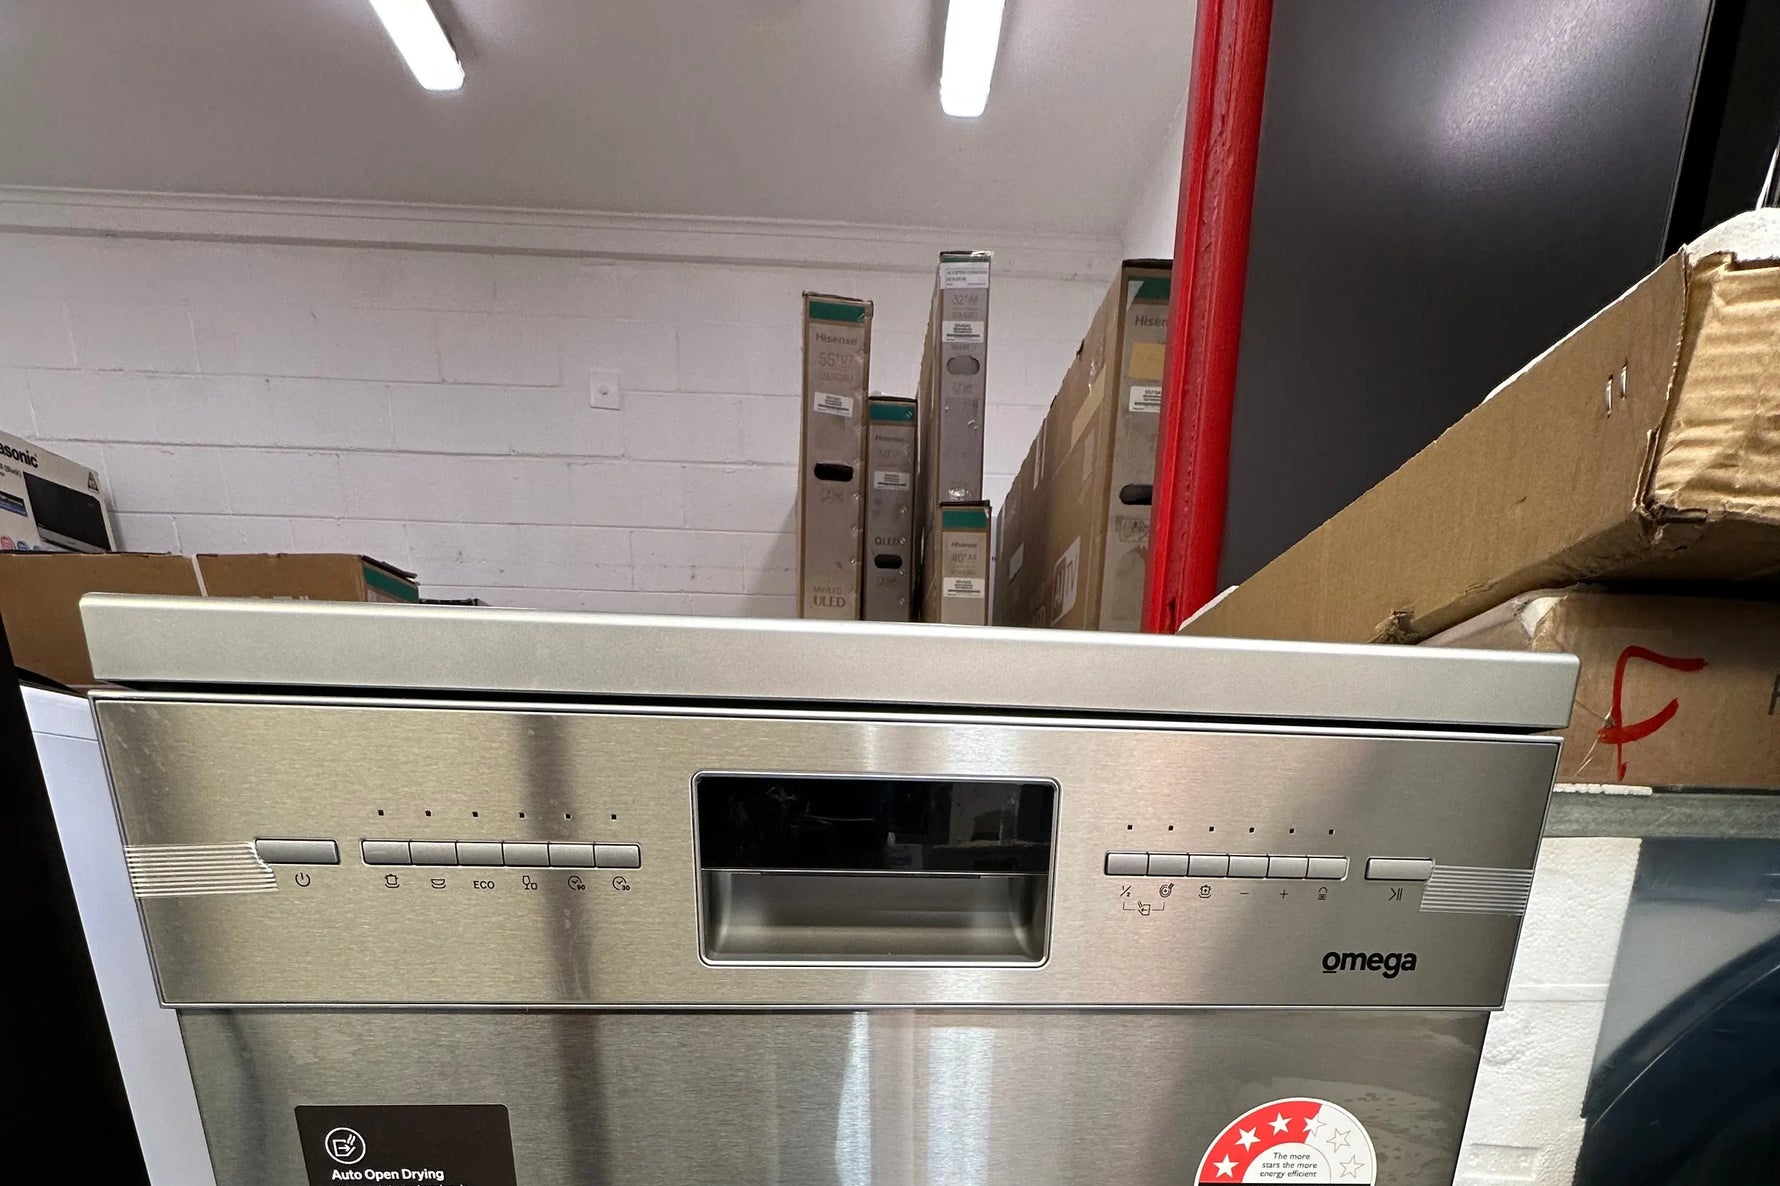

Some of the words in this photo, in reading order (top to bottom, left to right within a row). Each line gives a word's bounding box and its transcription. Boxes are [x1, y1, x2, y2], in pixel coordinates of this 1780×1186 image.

[1135, 315, 1168, 327] Hisen
[816, 332, 857, 345] Hisense
[0, 442, 38, 468] asonic
[813, 595, 846, 608] ULED
[473, 879, 495, 890] ECO
[1322, 951, 1417, 978] omega
[1273, 1152, 1287, 1160] The
[1262, 1161, 1280, 1169] stars
[1283, 1161, 1295, 1169] the
[332, 1170, 362, 1180] Auto
[364, 1169, 399, 1182] Open
[401, 1169, 444, 1182] Drying
[1260, 1172, 1285, 1180] energy
[1287, 1169, 1317, 1177] efficient
